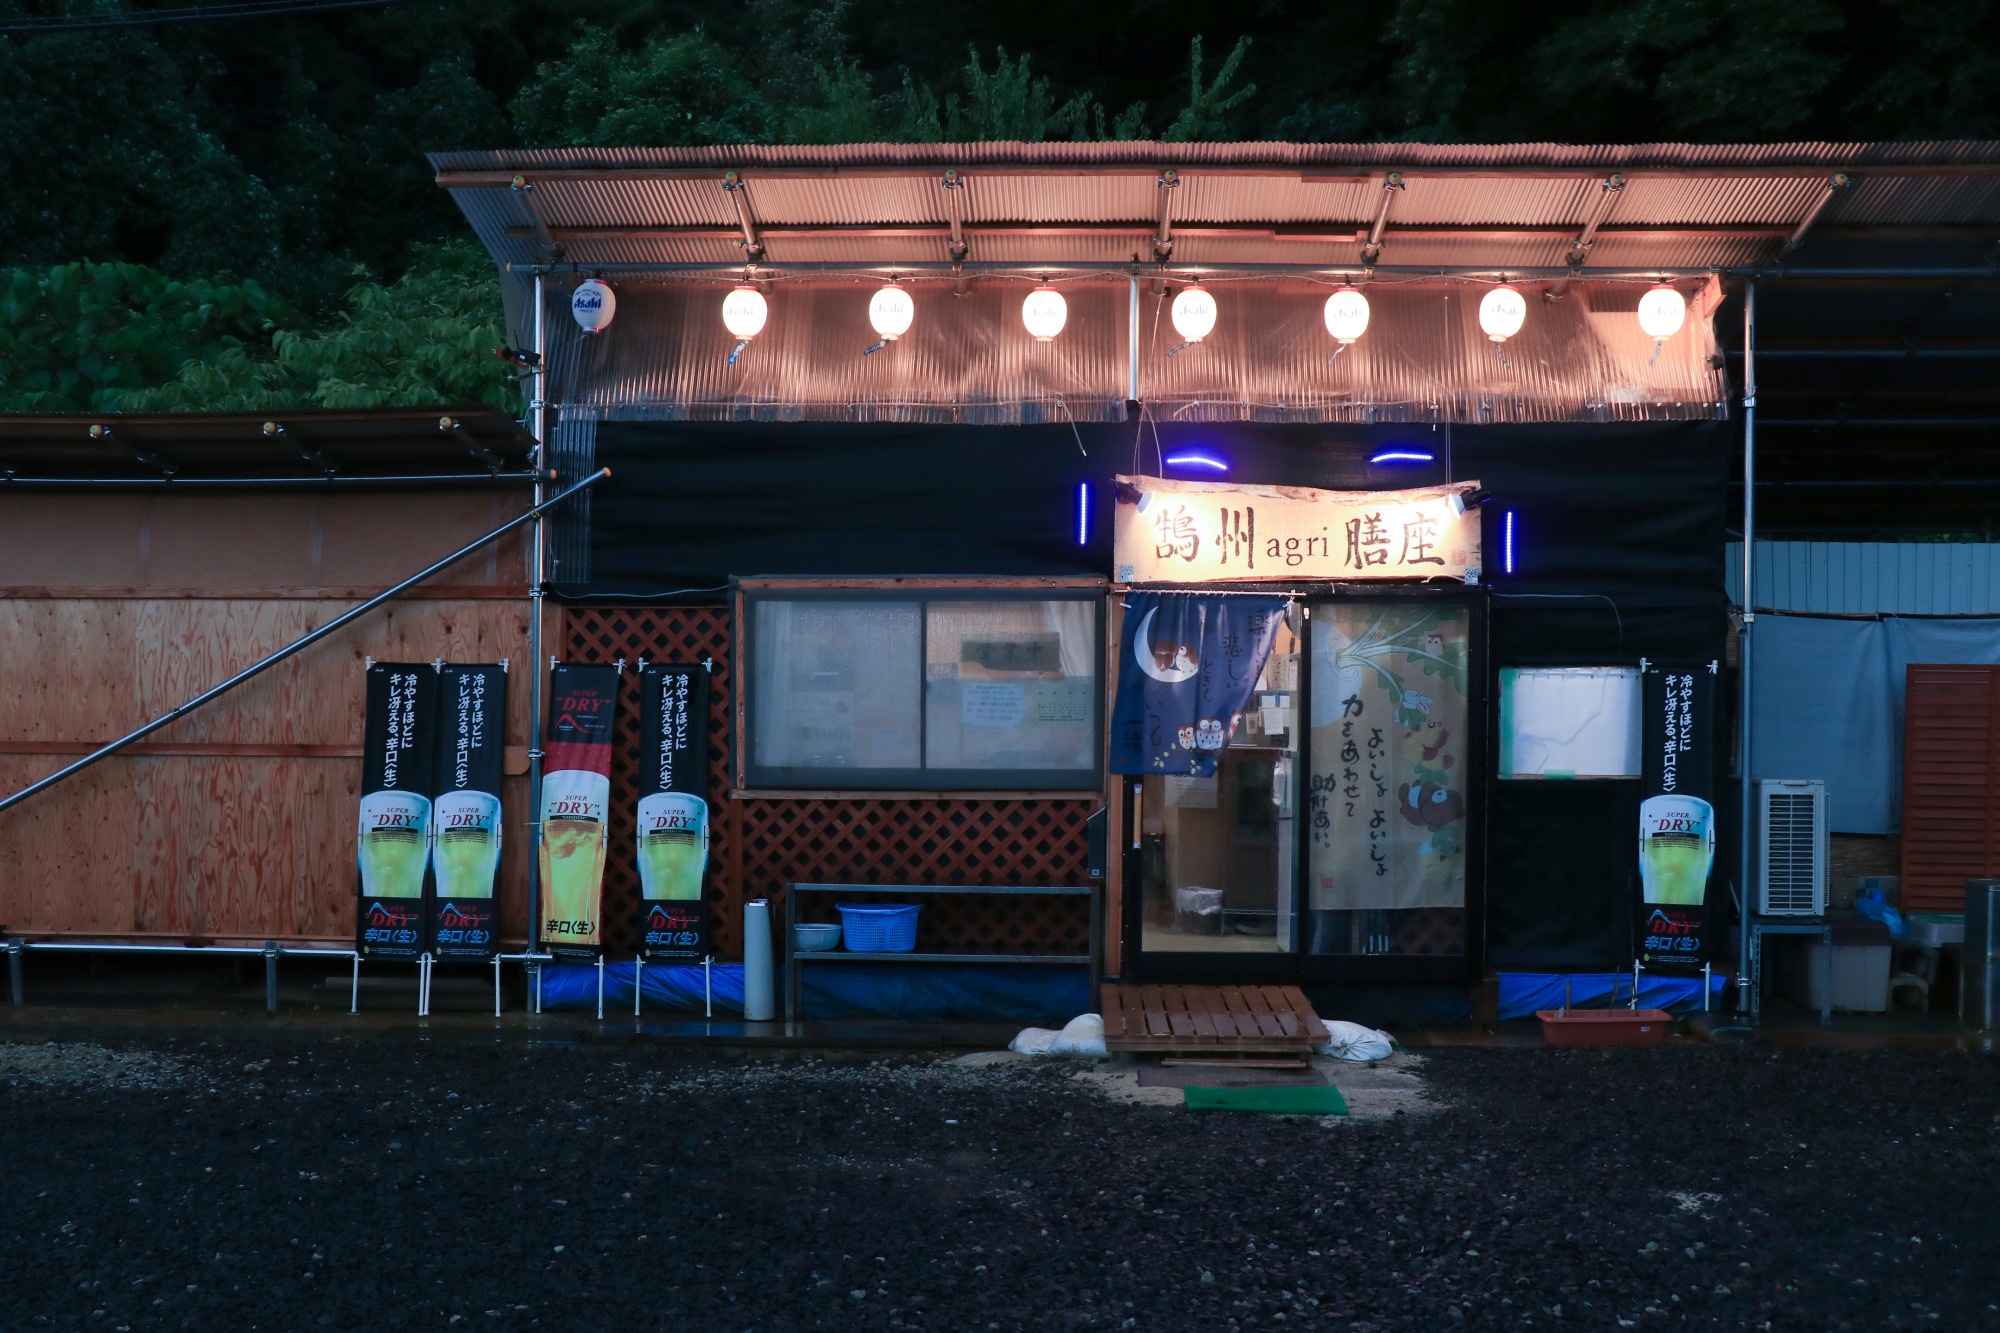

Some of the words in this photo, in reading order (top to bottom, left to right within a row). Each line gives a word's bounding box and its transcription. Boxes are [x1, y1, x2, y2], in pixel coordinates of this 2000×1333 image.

[574, 297, 602, 309] Asahi
[1266, 526, 1330, 567] agri
[1343, 512, 1446, 570] 膳座
[401, 673, 418, 749] 冷やすほどに
[471, 673, 486, 749] 冷やすほどに
[675, 673, 689, 750] 冷やすほどに
[1679, 674, 1694, 752] 冷やすほどに
[1340, 693, 1364, 817] 力をあわせて
[1367, 727, 1388, 798] よいしょ
[1369, 808, 1389, 877] よいしょ
